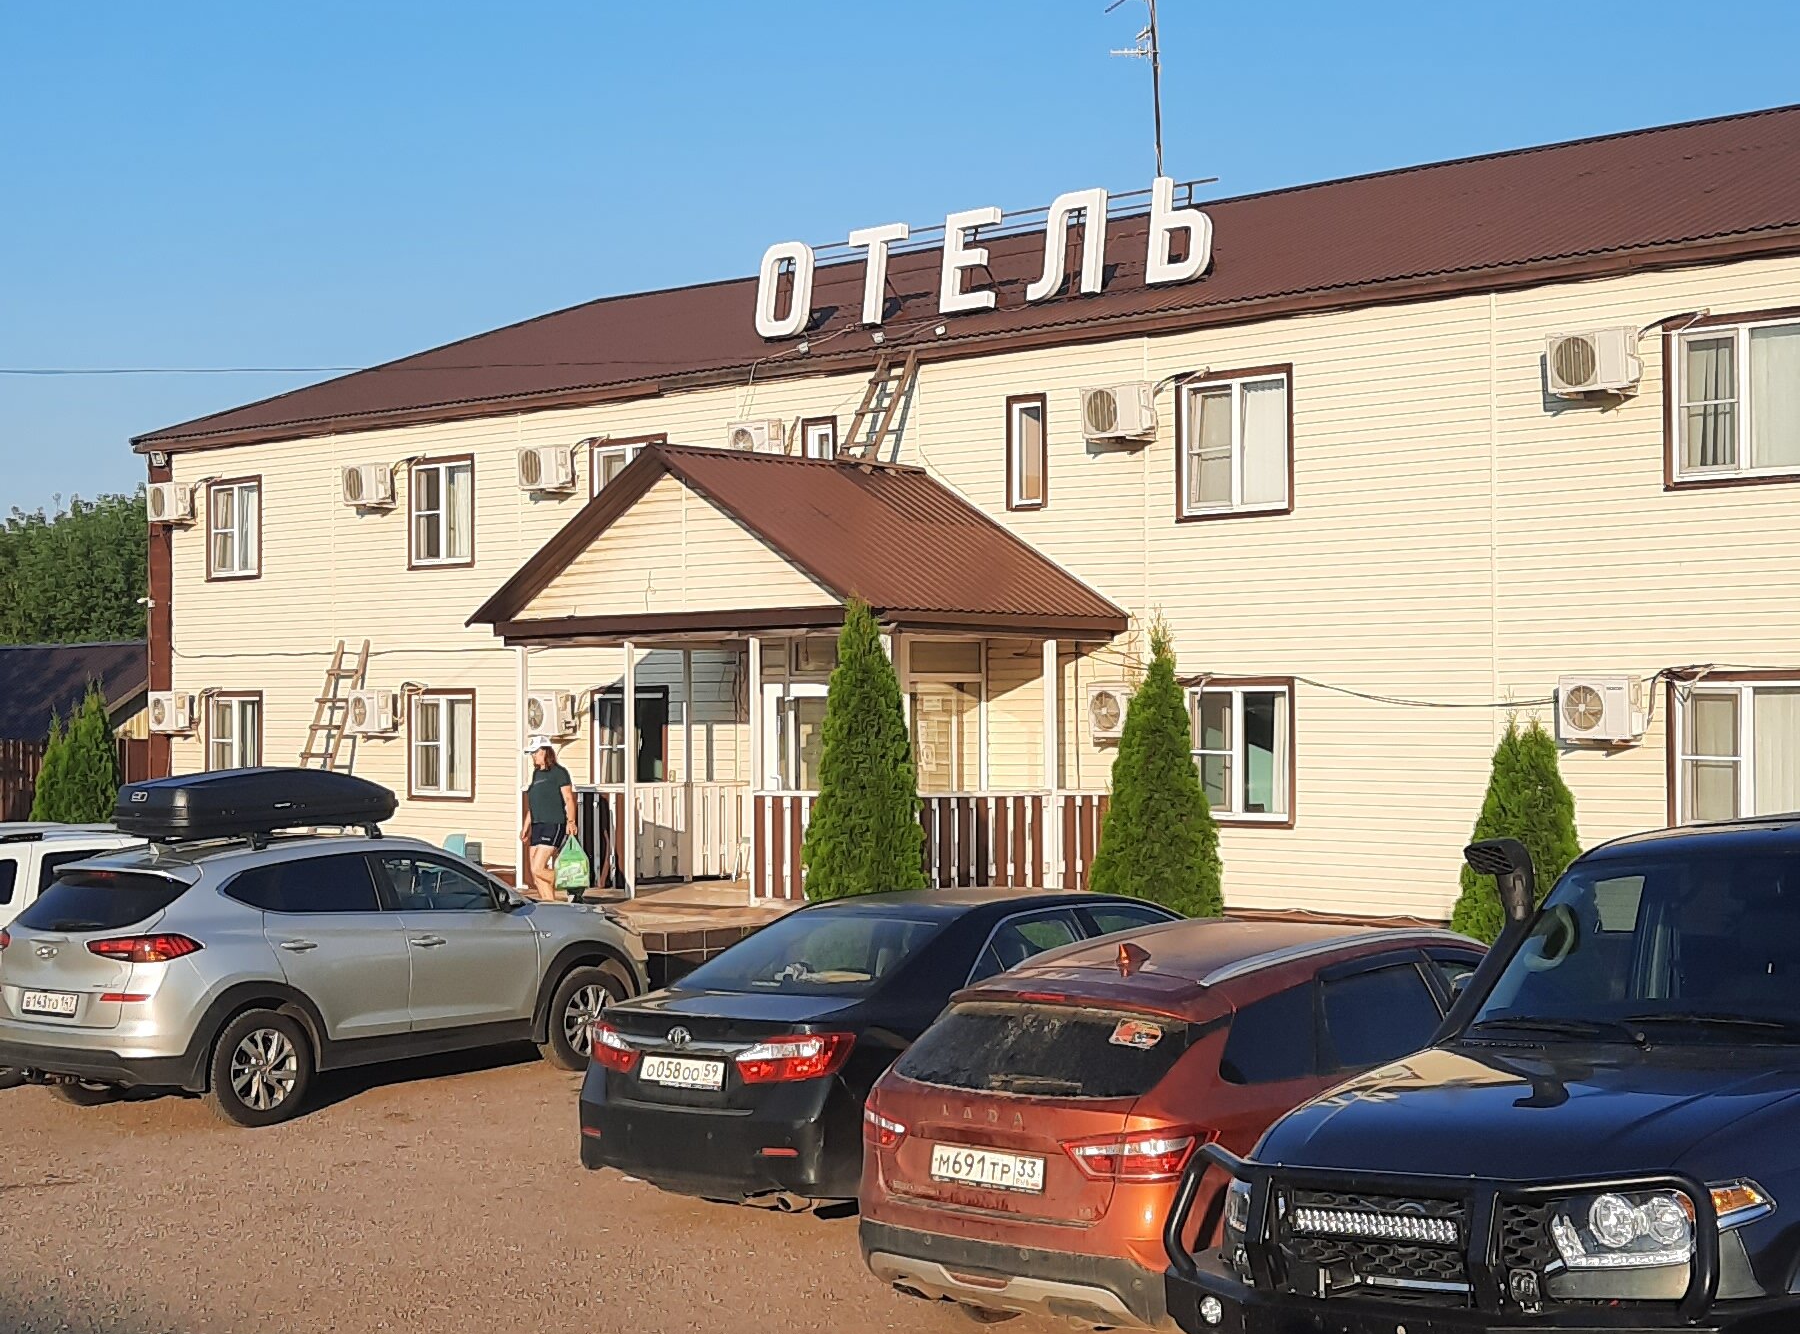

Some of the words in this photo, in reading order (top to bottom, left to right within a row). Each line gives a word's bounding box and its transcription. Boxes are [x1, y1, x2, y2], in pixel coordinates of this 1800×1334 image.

[755, 176, 1214, 339] ОТЕЛЬ
[646, 1060, 700, 1081] О058ОО
[703, 1063, 719, 1078] 59
[943, 1104, 1025, 1130] LADA
[938, 1152, 1011, 1181] М691ТР
[1017, 1159, 1037, 1178] 33
